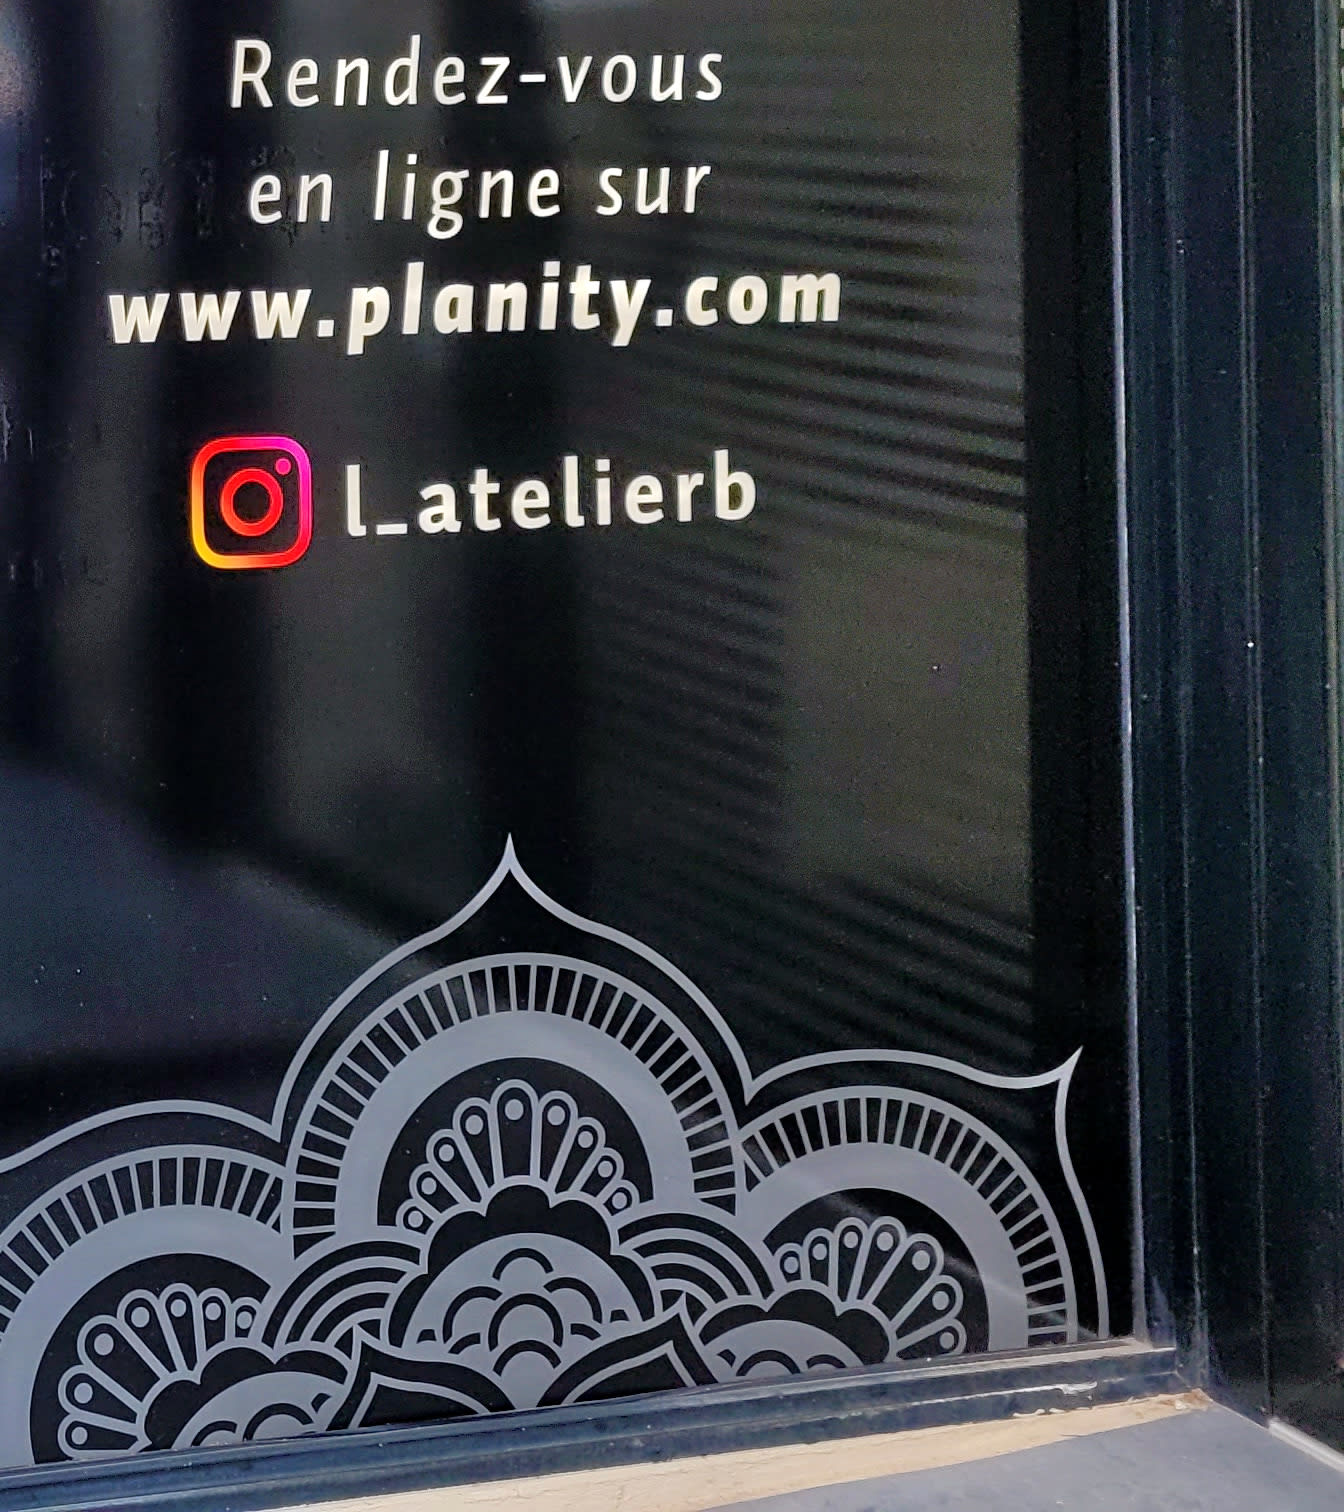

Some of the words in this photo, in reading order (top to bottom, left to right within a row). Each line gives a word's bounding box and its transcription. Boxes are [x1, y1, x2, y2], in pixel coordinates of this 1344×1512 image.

[230, 34, 725, 109] Rendez-vous
[248, 160, 332, 226] en
[373, 150, 562, 240] ligne
[597, 160, 711, 218] sur
[108, 261, 842, 355] www.planity.com
[342, 449, 758, 539] l_atelierb
